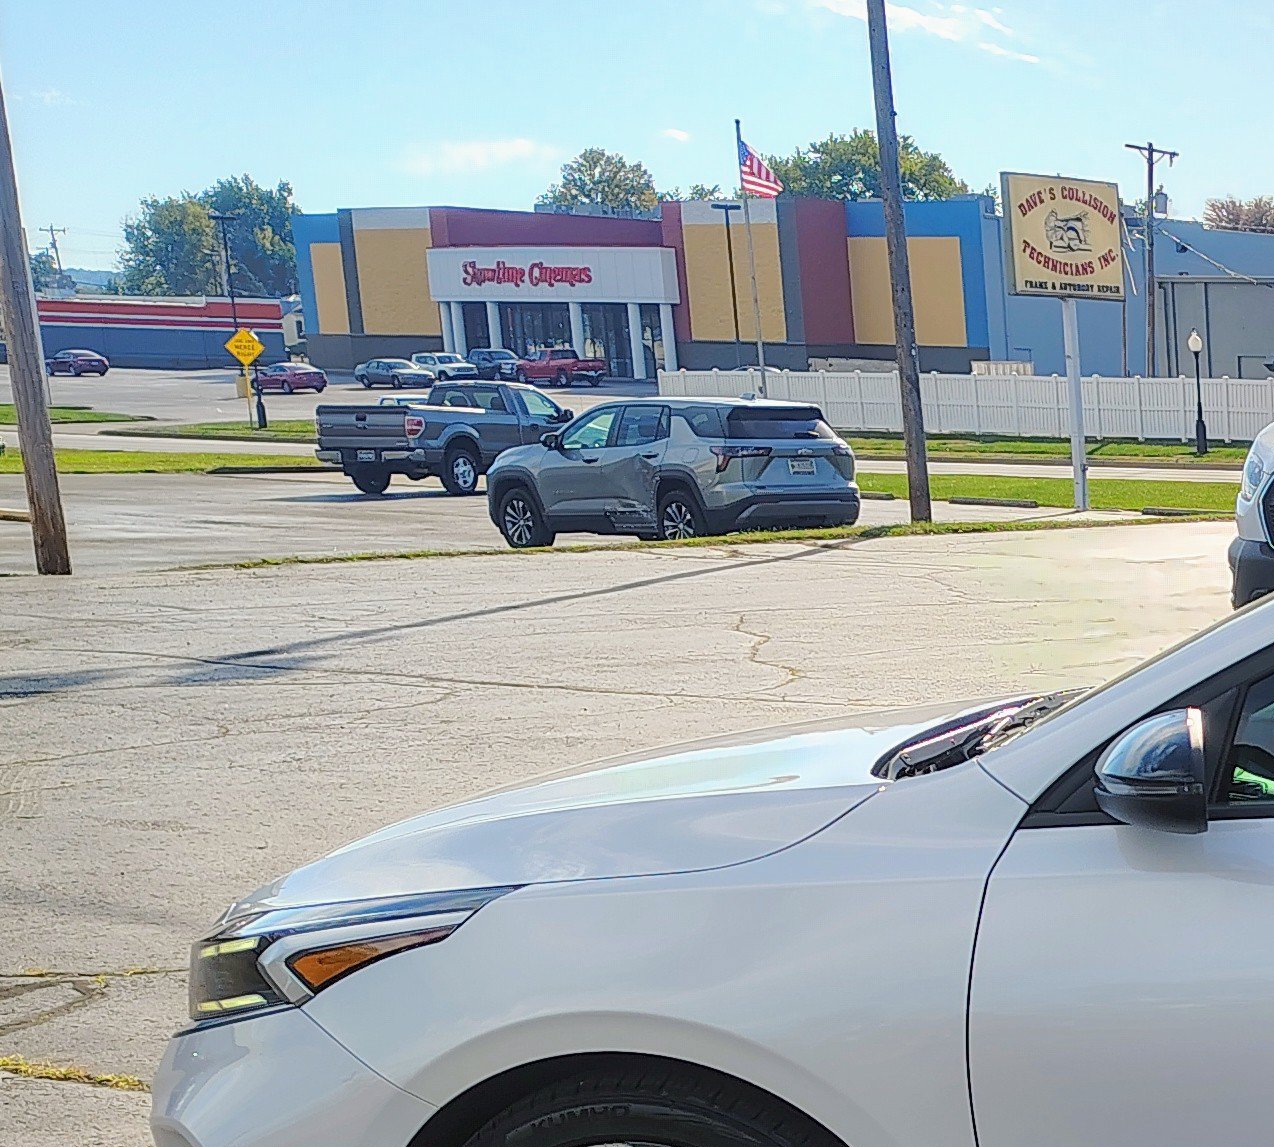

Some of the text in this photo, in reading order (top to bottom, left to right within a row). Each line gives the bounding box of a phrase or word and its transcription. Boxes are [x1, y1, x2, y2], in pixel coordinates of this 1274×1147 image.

[1017, 185, 1117, 225] DAVE'S COLLISION
[1022, 239, 1119, 277] TECHNICIANS INC.
